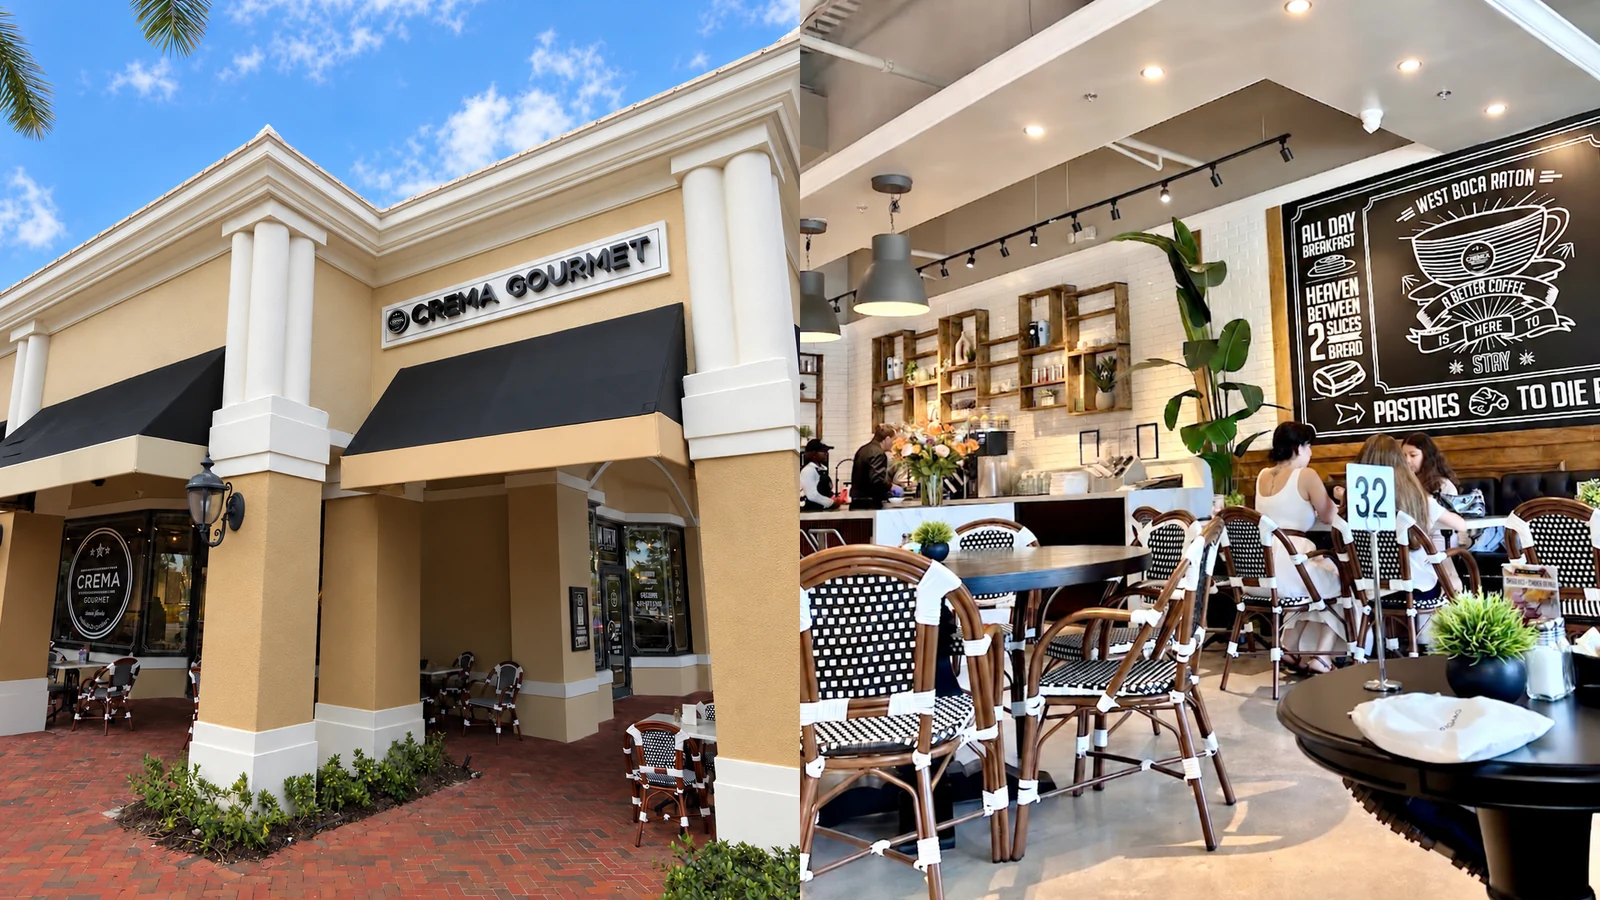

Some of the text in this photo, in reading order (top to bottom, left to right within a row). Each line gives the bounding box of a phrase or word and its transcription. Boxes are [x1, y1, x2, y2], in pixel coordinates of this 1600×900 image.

[1415, 168, 1535, 214] WEST BOCA RATON
[1301, 211, 1356, 244] ALL DAY
[1302, 233, 1356, 258] BREAKFAST
[411, 235, 650, 325] CREMA GOURMET
[1305, 276, 1360, 306] HEAVEN
[1441, 279, 1526, 309] A BETTER COFFEE
[1307, 297, 1361, 323] BETWEEN
[1326, 316, 1362, 336] SLICES
[1438, 315, 1540, 346] IS HERE TO
[1308, 322, 1326, 362] 2
[1328, 340, 1364, 360] BREAD
[1472, 350, 1511, 374] STAY
[1373, 393, 1460, 424] PASTRIES
[1516, 383, 1547, 411] TO
[1551, 379, 1589, 408] DIE
[1355, 475, 1387, 518] 32
[76, 572, 120, 589] CREMA
[83, 596, 110, 604] GOURMET
